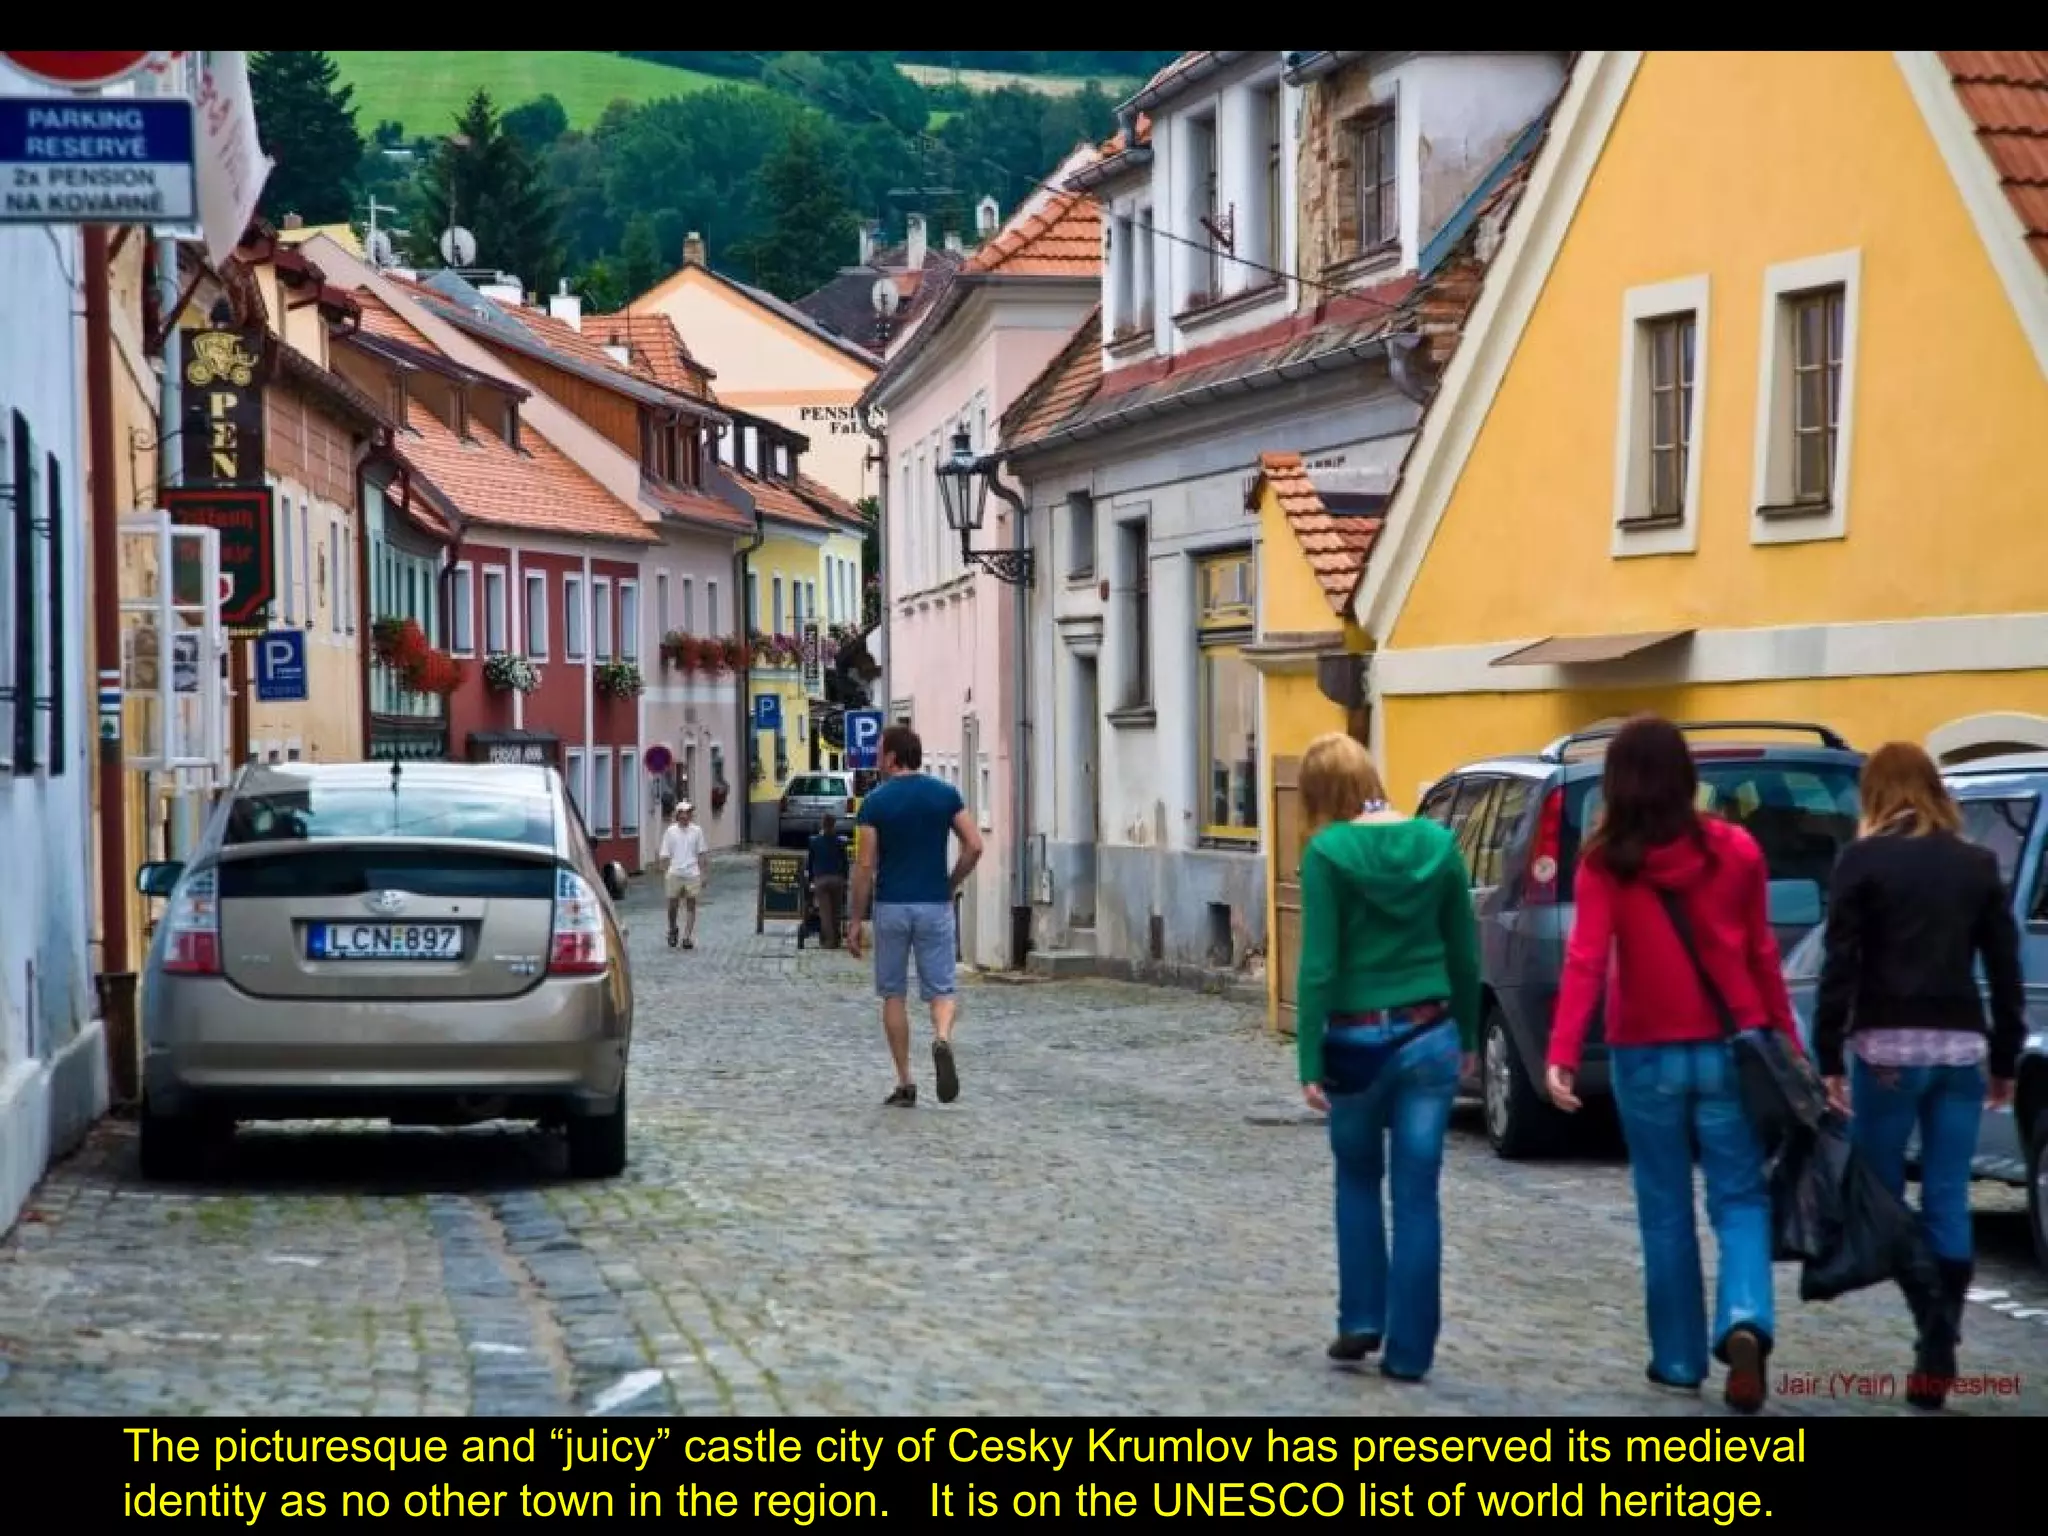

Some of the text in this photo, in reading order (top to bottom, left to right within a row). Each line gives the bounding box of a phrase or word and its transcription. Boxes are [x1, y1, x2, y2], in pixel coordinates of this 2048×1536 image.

[27, 108, 144, 130] PARKING
[13, 168, 156, 187] 2x PENSION
[6, 191, 42, 212] NA
[800, 406, 884, 421] PENSIN
[210, 391, 239, 486] PEN
[265, 640, 294, 680] P
[759, 699, 775, 718] P
[855, 717, 877, 747] P
[330, 926, 457, 951] LCN 897
